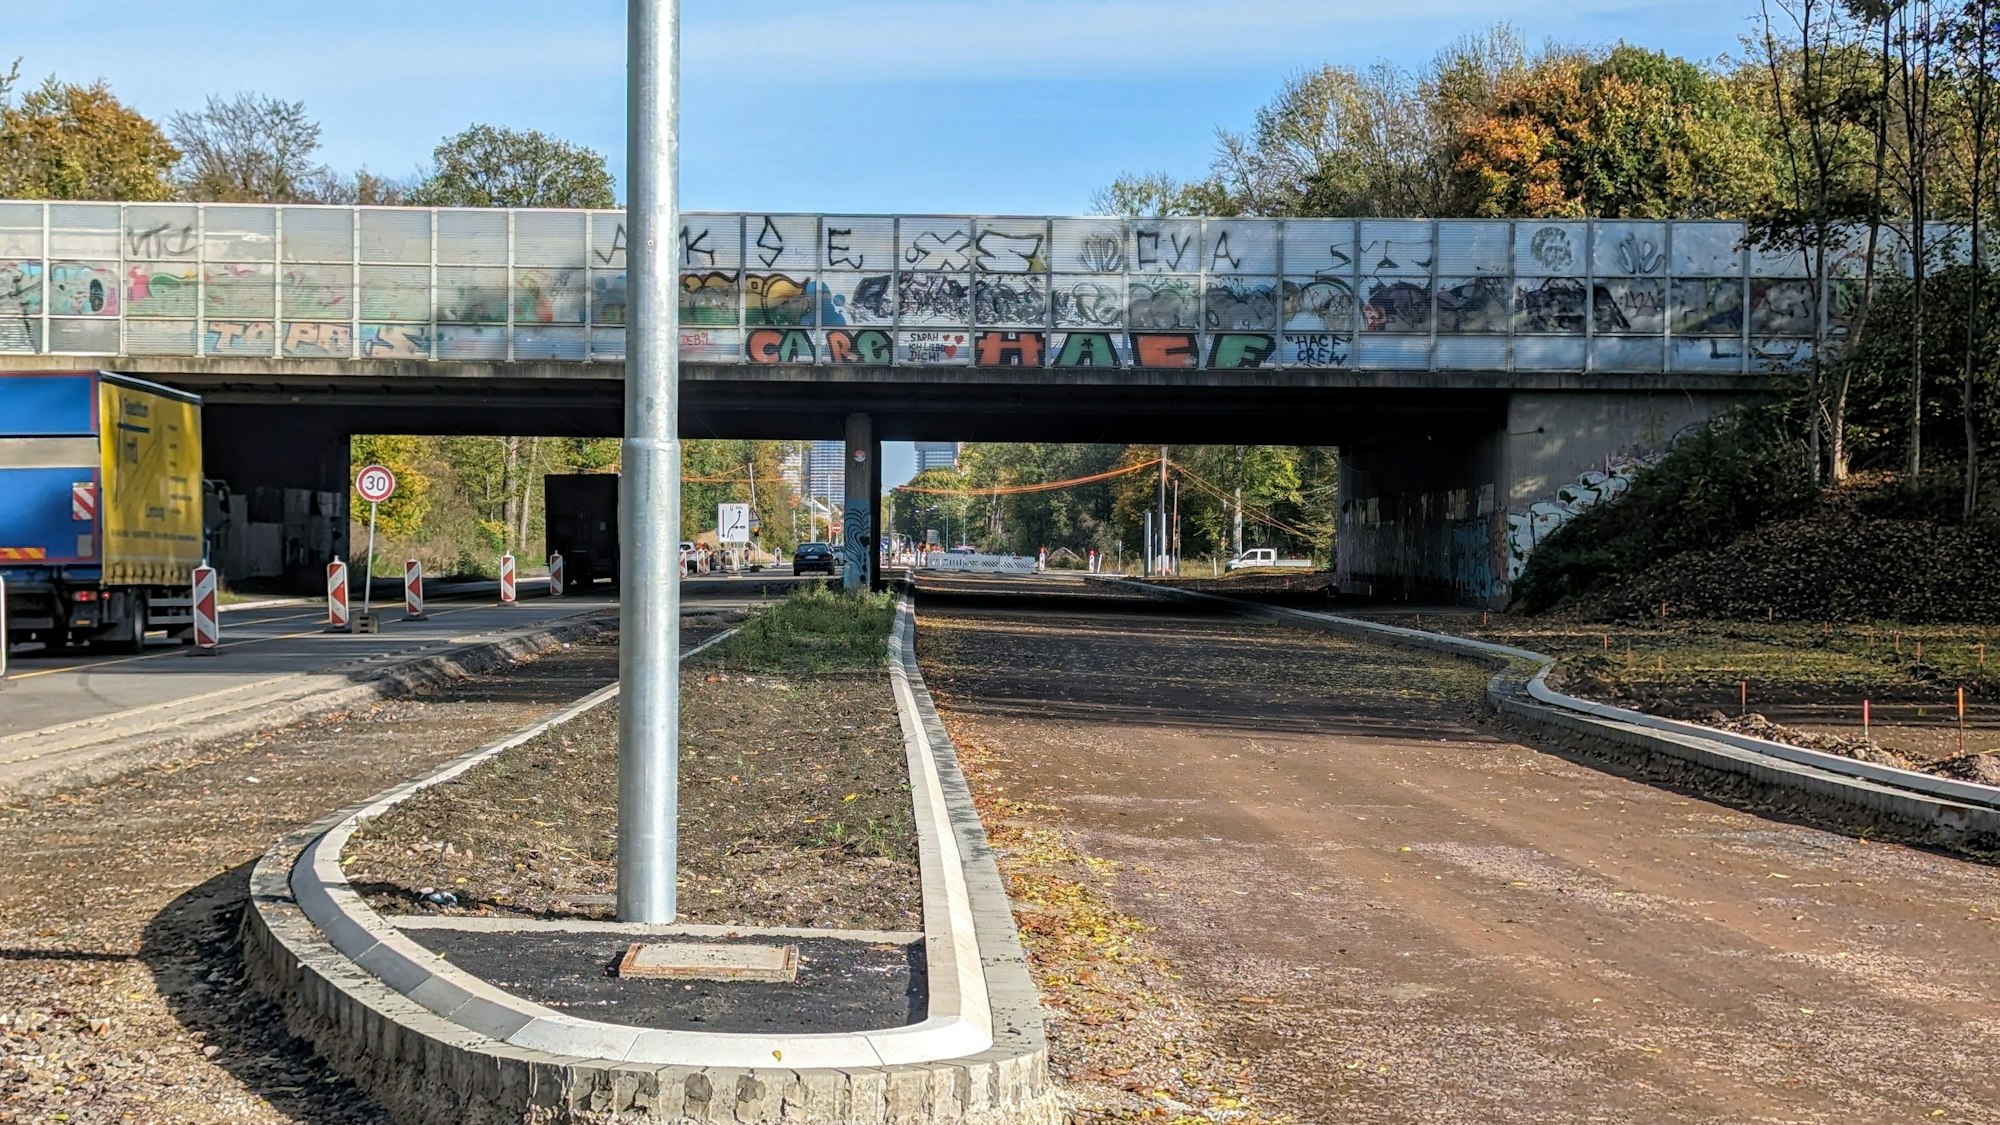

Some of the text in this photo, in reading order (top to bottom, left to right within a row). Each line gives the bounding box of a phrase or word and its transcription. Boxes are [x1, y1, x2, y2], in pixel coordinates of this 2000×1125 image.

[923, 341, 945, 352] LIEBE
[907, 349, 940, 362] DICH!
[1296, 347, 1349, 367] CREW
[364, 474, 387, 493] 30
